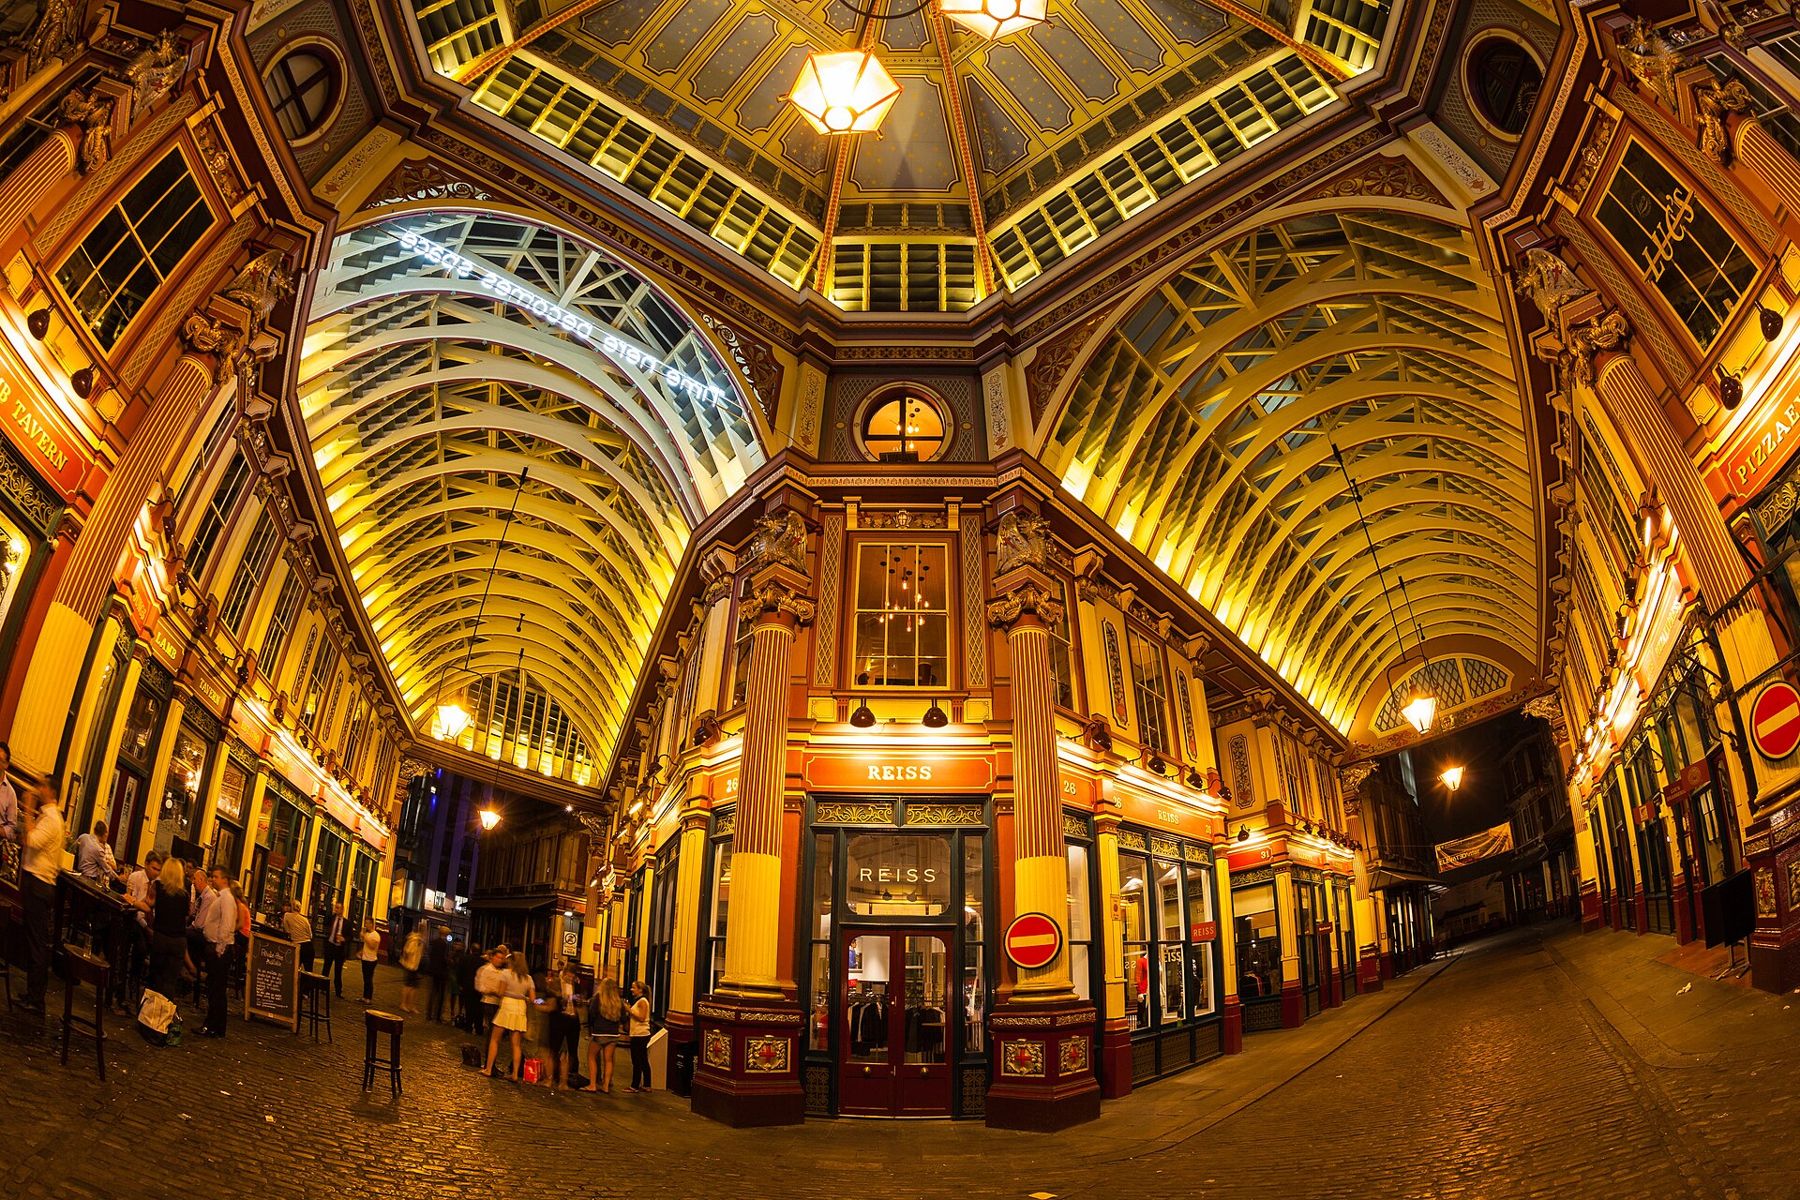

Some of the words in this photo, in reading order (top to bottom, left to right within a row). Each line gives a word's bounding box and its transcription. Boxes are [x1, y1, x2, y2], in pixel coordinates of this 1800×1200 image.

[508, 168, 716, 297] LEADENHALL
[1129, 190, 1264, 277] MARKET
[11, 399, 69, 472] TAVERN
[1736, 394, 1800, 485] PIZZAE
[154, 631, 178, 661] LAMB
[199, 677, 222, 706] TAVERN
[867, 763, 933, 782] REISS
[1063, 780, 1076, 795] 26
[1157, 809, 1179, 825] REISS
[1260, 850, 1270, 859] 31
[859, 868, 937, 883] REISS
[1192, 926, 1215, 937] REISS
[1163, 951, 1181, 963] EISS
